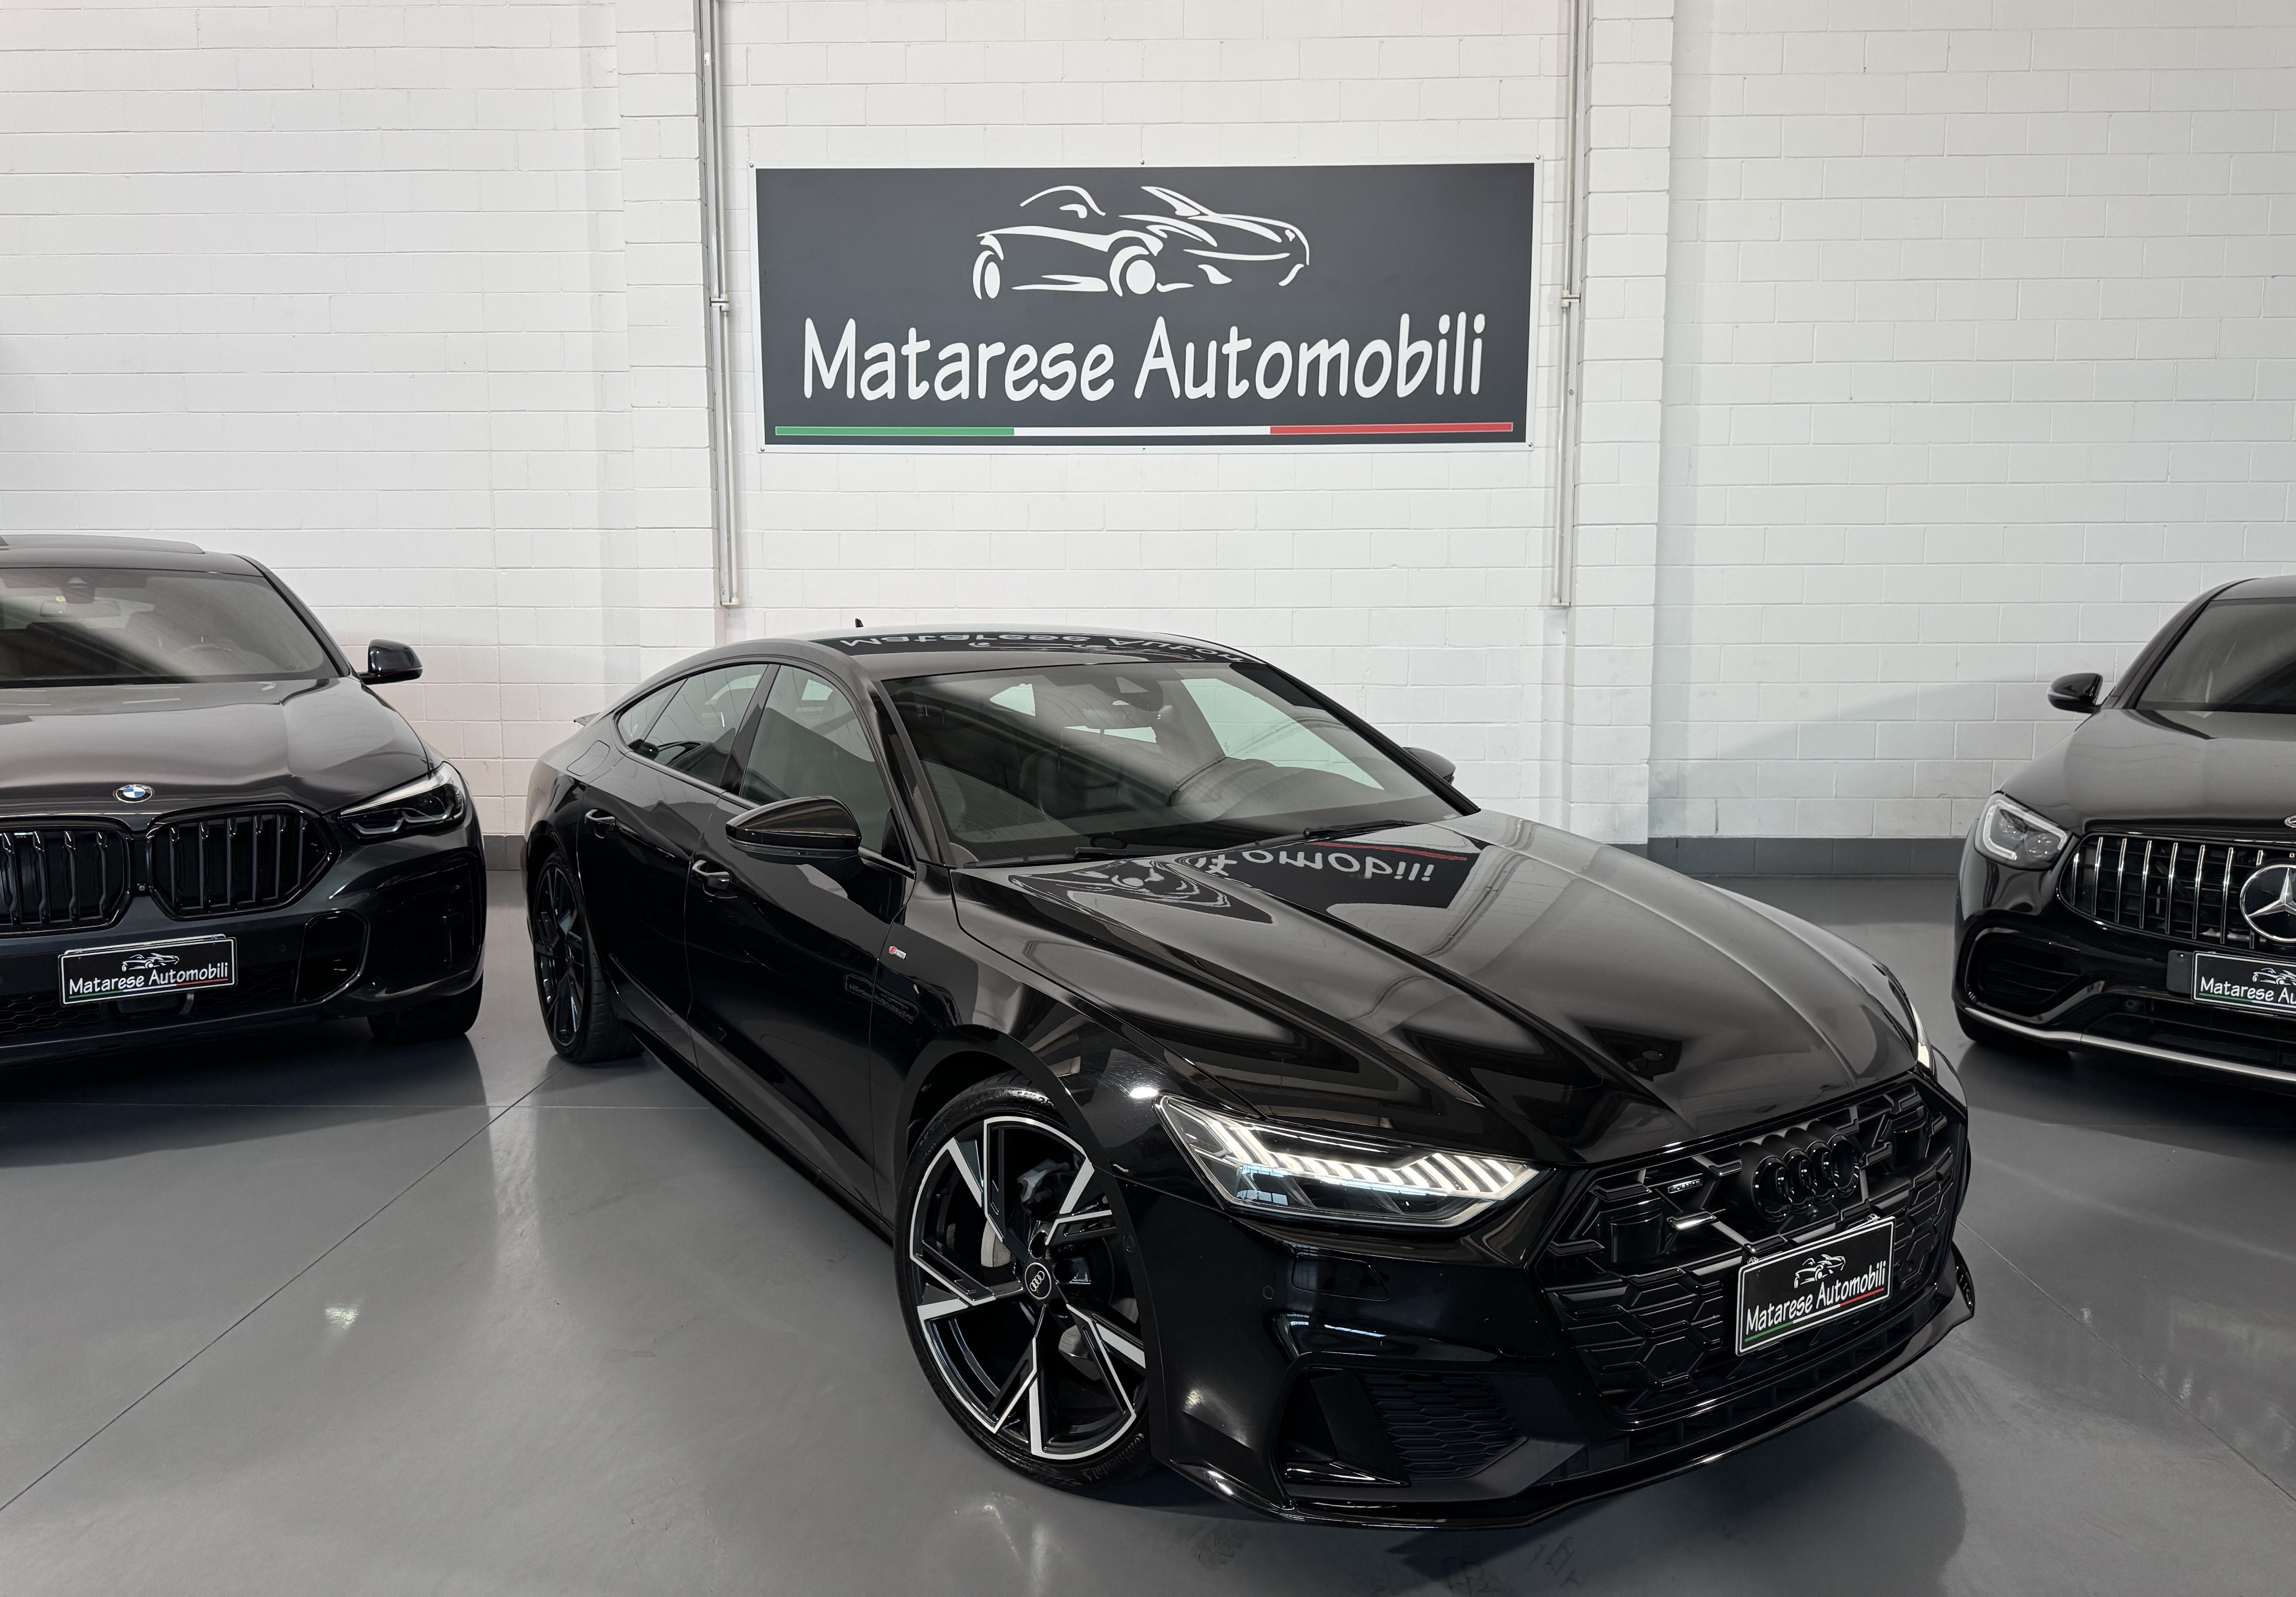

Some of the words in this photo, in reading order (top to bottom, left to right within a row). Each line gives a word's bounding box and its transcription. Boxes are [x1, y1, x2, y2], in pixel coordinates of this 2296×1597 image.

[804, 317, 1114, 401] Matarese
[1134, 311, 1486, 399] Automobili
[70, 975, 144, 995] Matarese
[149, 962, 228, 985] Automobili
[2200, 976, 2274, 1001] Matarese
[1746, 1294, 1813, 1335] Matarese
[1816, 1260, 1886, 1309] Automobili
